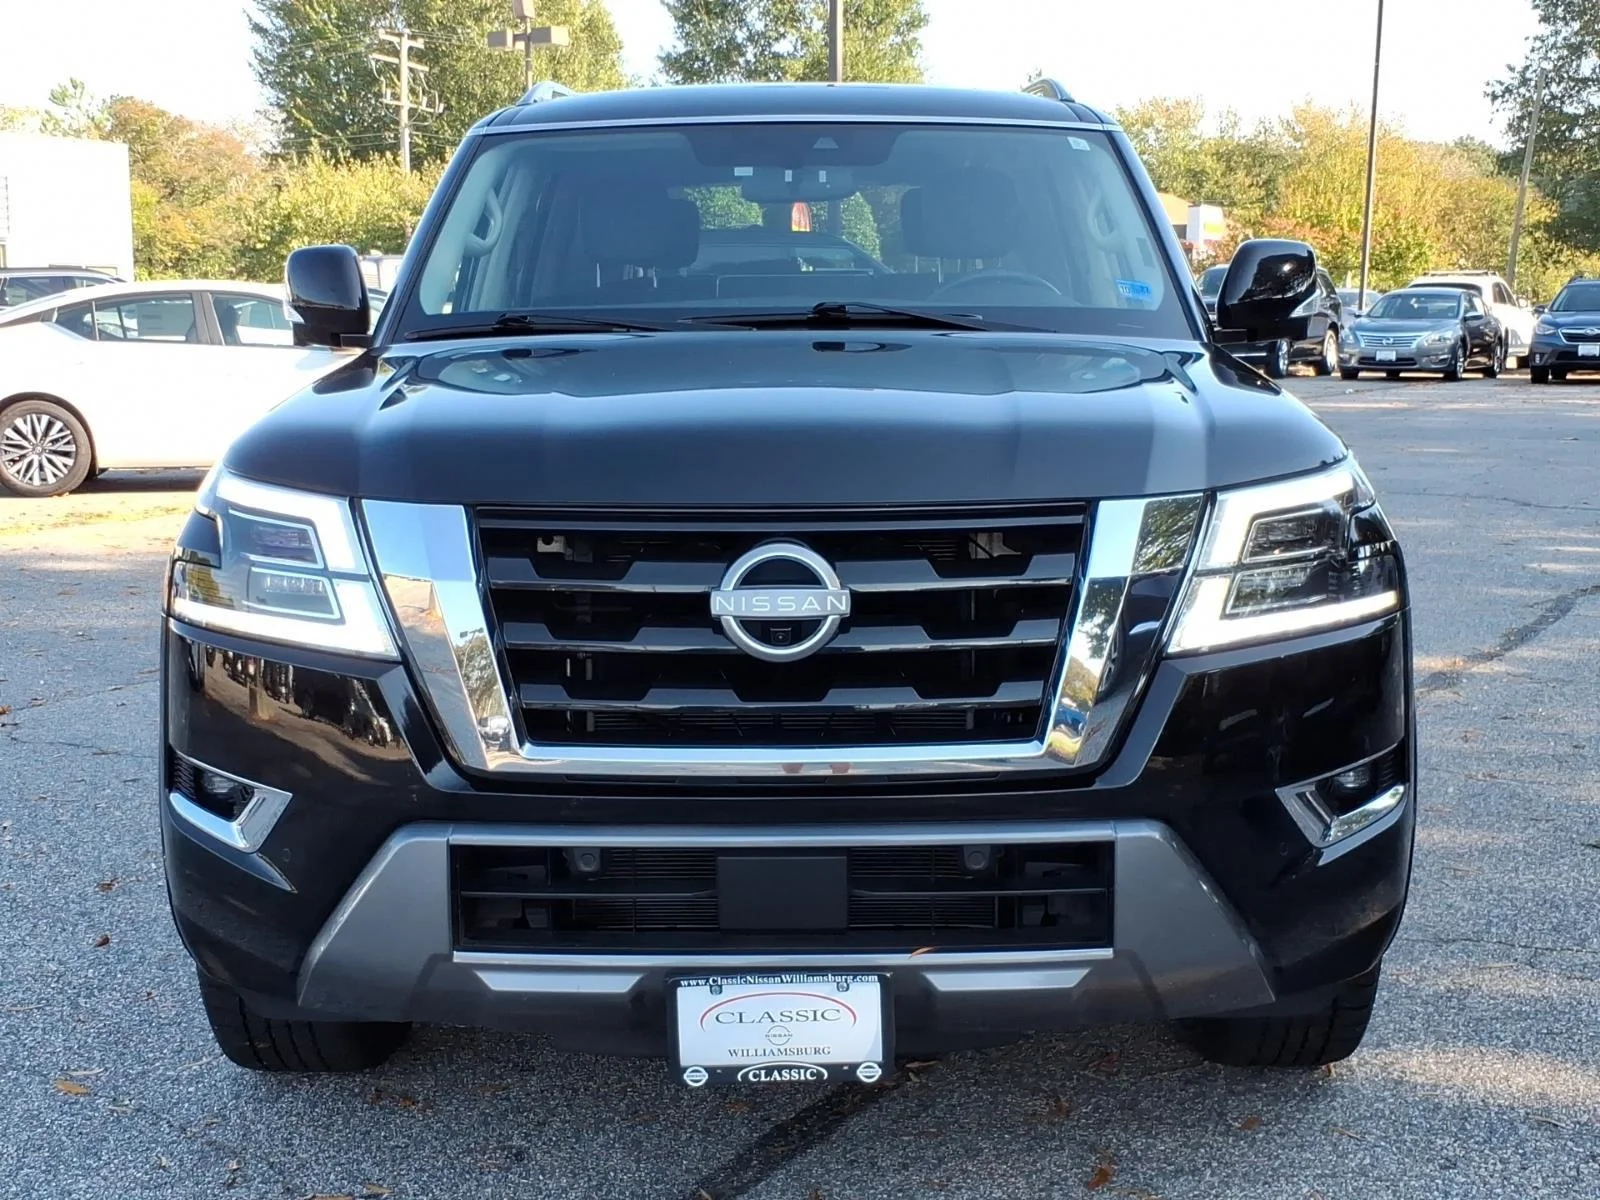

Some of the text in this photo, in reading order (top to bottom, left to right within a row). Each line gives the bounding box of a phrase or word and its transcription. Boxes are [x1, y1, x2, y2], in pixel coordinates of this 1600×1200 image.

[715, 595, 846, 612] NISSAN
[680, 974, 878, 987] www.ClassicNissanWilliamsburg.com
[715, 1008, 841, 1024] CLASSIC
[728, 1046, 831, 1058] WILLIAMSBURG
[748, 1068, 818, 1082] CLASSIC
